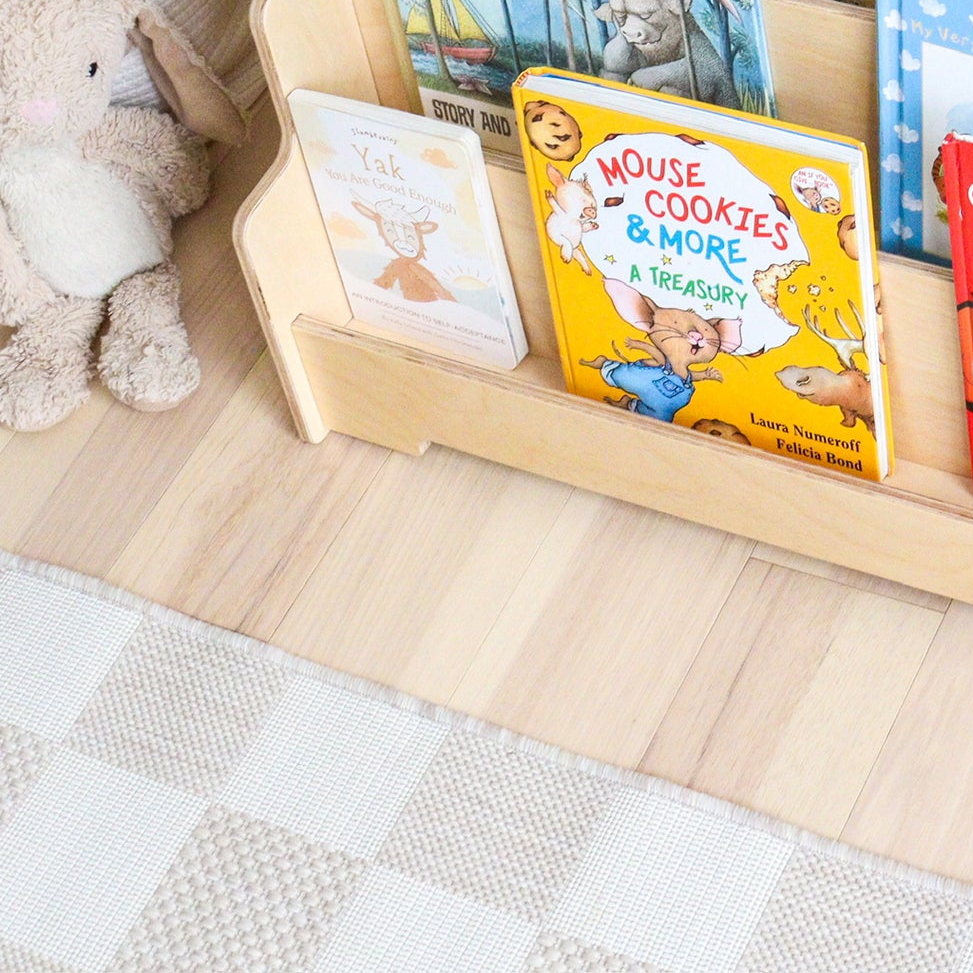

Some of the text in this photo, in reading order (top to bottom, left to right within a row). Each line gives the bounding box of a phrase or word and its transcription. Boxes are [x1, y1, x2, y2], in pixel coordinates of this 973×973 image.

[910, 18, 932, 38] My
[432, 98, 512, 137] STORY AND
[351, 144, 405, 180] Yak
[597, 148, 706, 187] MOUSE
[325, 168, 457, 214] You Are Good Enough
[644, 190, 788, 251] COOKIES
[626, 214, 748, 285] & MORE
[629, 263, 748, 310] A TREASURY
[750, 412, 861, 453] Laura Numeroff
[776, 438, 863, 472] Felicia Bond
